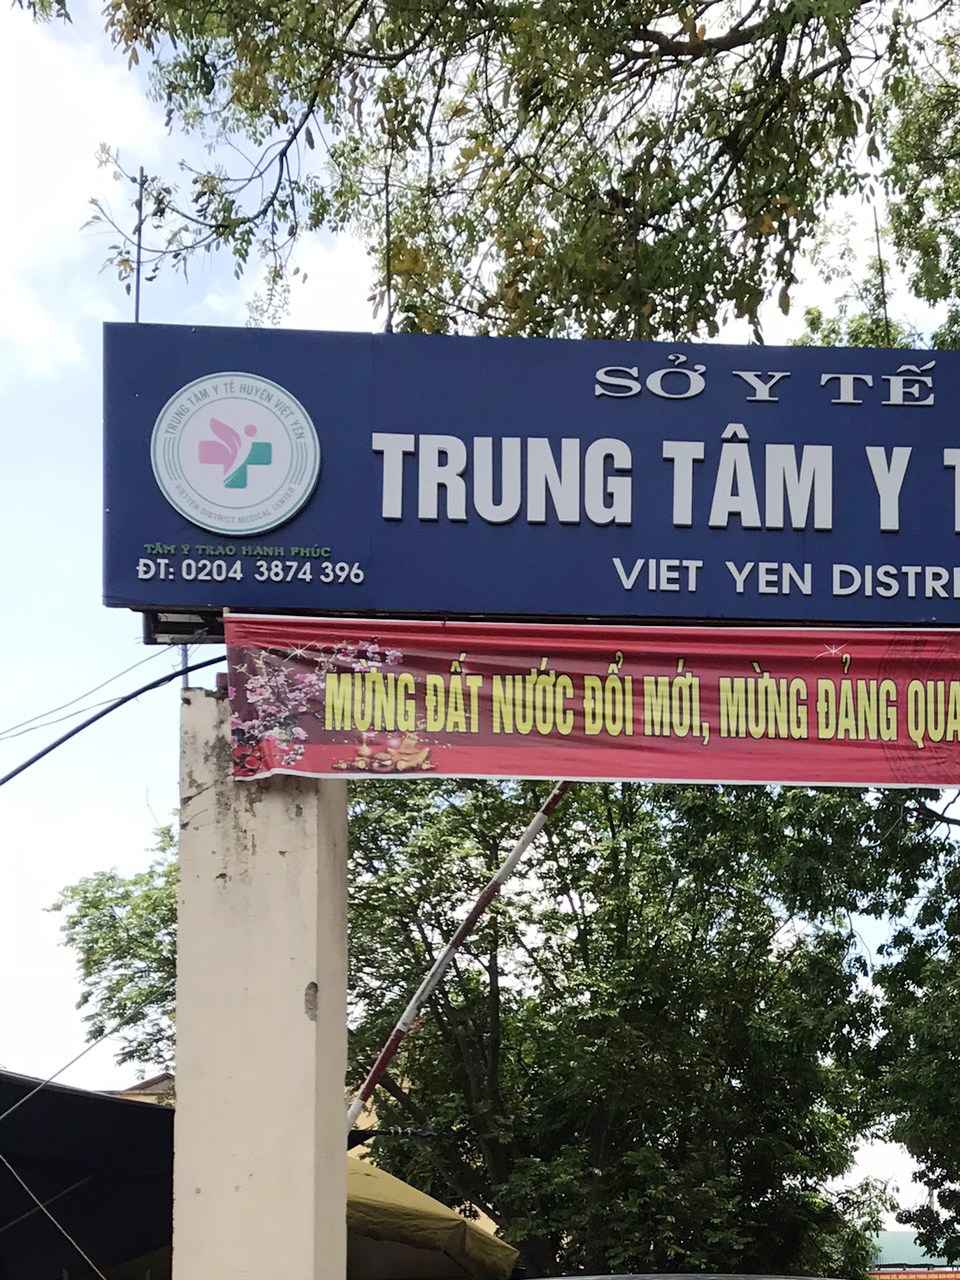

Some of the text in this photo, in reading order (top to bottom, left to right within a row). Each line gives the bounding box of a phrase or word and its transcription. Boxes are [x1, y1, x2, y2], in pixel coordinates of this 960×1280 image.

[595, 353, 706, 399] SỞ
[732, 371, 791, 401] Y
[821, 360, 936, 407] TẾ
[372, 432, 633, 527] TRUNG
[663, 423, 834, 531] TÂM
[866, 446, 912, 534] Y
[136, 558, 364, 583] ĐT: 0204 3874 396
[180, 544, 190, 555] Y
[195, 544, 236, 556] TRAO
[612, 556, 704, 592] VIET
[725, 561, 813, 597] YEN
[323, 657, 416, 735] MỪNG
[425, 652, 483, 734] ĐẤT
[492, 657, 575, 736] NƯỚC
[583, 650, 633, 737] ĐỔI
[644, 659, 711, 746] MỚI,
[718, 661, 808, 740] MỪNG
[816, 653, 897, 741] ĐẢNG
